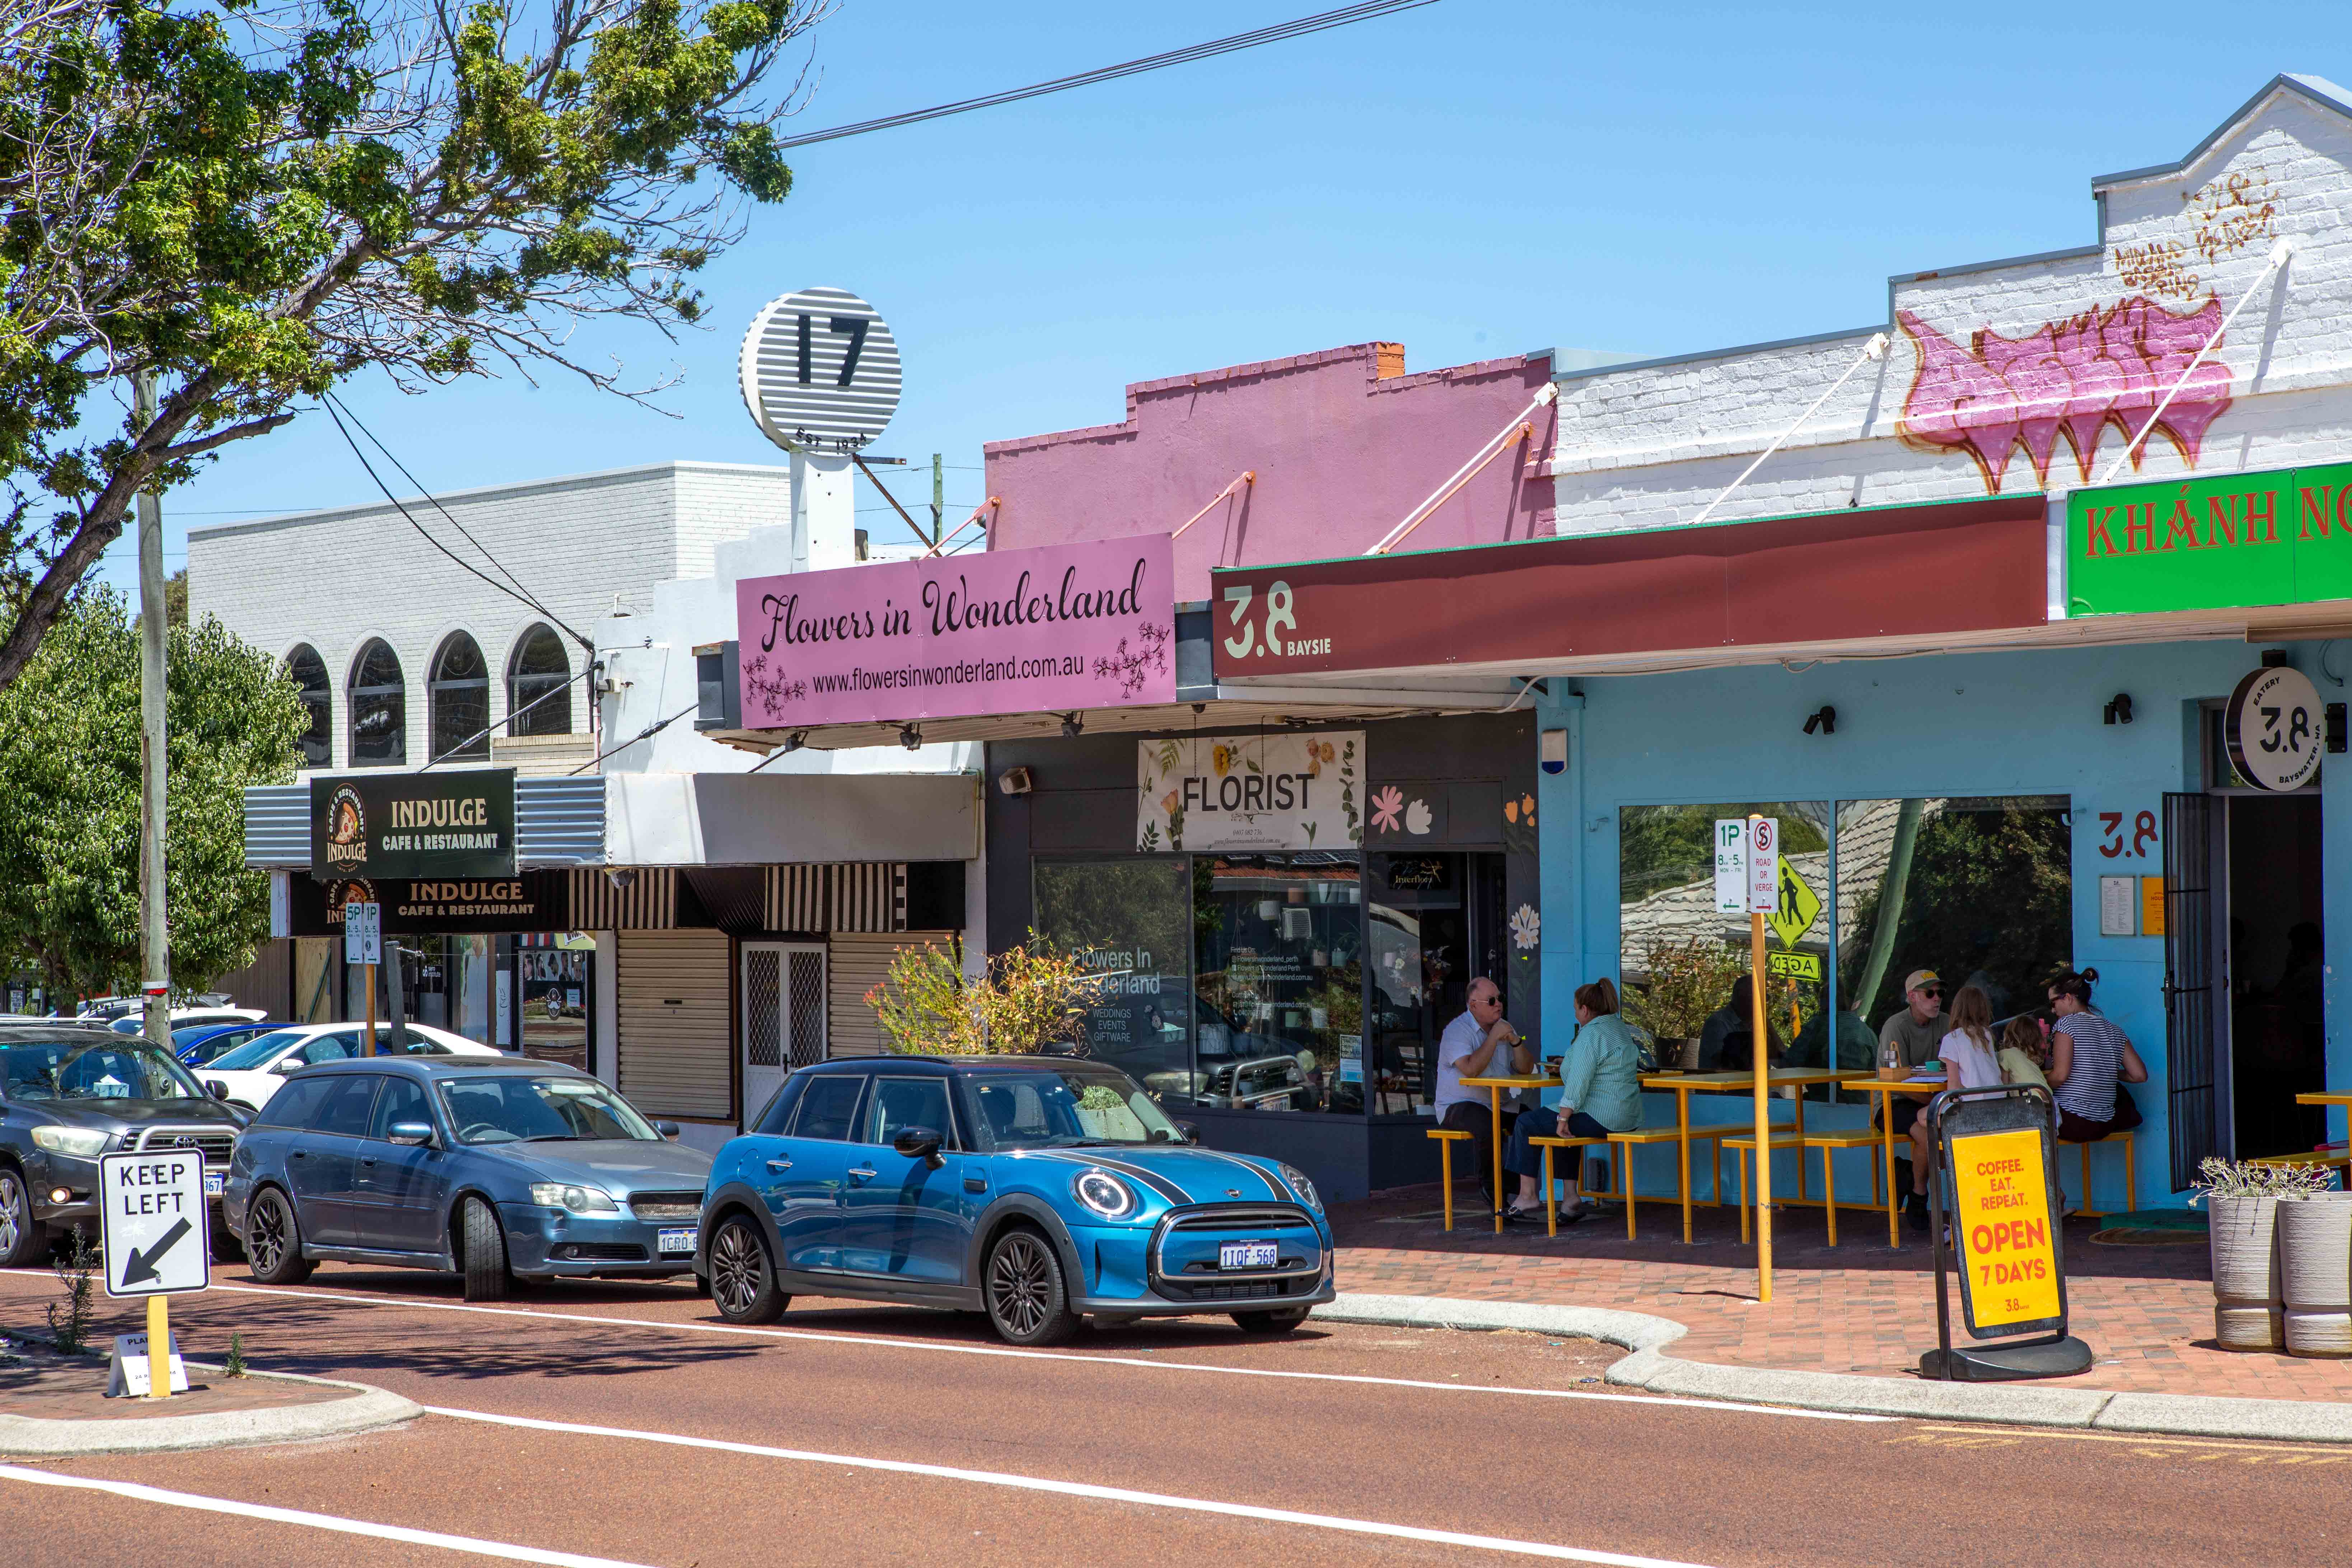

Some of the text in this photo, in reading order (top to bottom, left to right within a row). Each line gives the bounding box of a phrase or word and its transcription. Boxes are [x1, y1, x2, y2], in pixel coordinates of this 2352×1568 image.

[799, 315, 869, 386] 17
[796, 427, 867, 450] EST 1934
[2085, 485, 2281, 559] KHÁNH
[761, 558, 1146, 652] Flowers in Wonderland
[1224, 580, 1331, 658] 3.8 BAYSIE
[813, 655, 1084, 694] www.flowersinwonderland.com.au
[2253, 677, 2280, 706] EATERY
[2260, 706, 2309, 753] 3.8
[2279, 724, 2320, 783] BAYSWATER WA
[1183, 773, 1315, 812] FLORIST
[338, 788, 364, 833] RESTAURANT
[391, 799, 487, 828] INDULGE
[383, 833, 498, 851] CAFE & RESTAURANT
[1721, 825, 1740, 846] 1P
[2099, 810, 2158, 858] 3.8
[327, 842, 367, 863] INDULGE
[410, 883, 523, 901] INDULGE
[347, 906, 361, 921] 5P
[367, 906, 377, 921] 1P
[398, 904, 534, 916] CAFE & RESTAURANT
[1072, 946, 1151, 968] Flowers In
[1093, 1009, 1131, 1018] WEDDINGS
[1098, 1021, 1126, 1030] EVENTS
[1094, 1032, 1131, 1042] GIFTWARE
[121, 1164, 185, 1186] KEEP
[1977, 1159, 2024, 1176] COFFEE.
[1990, 1177, 2015, 1192] EAT.
[125, 1192, 183, 1216] LEFT
[1981, 1192, 2028, 1211] REPEAT.
[1972, 1218, 2046, 1254] OPEN
[1980, 1258, 2046, 1287] 7 DAYS
[2005, 1298, 2019, 1312] 3.8
